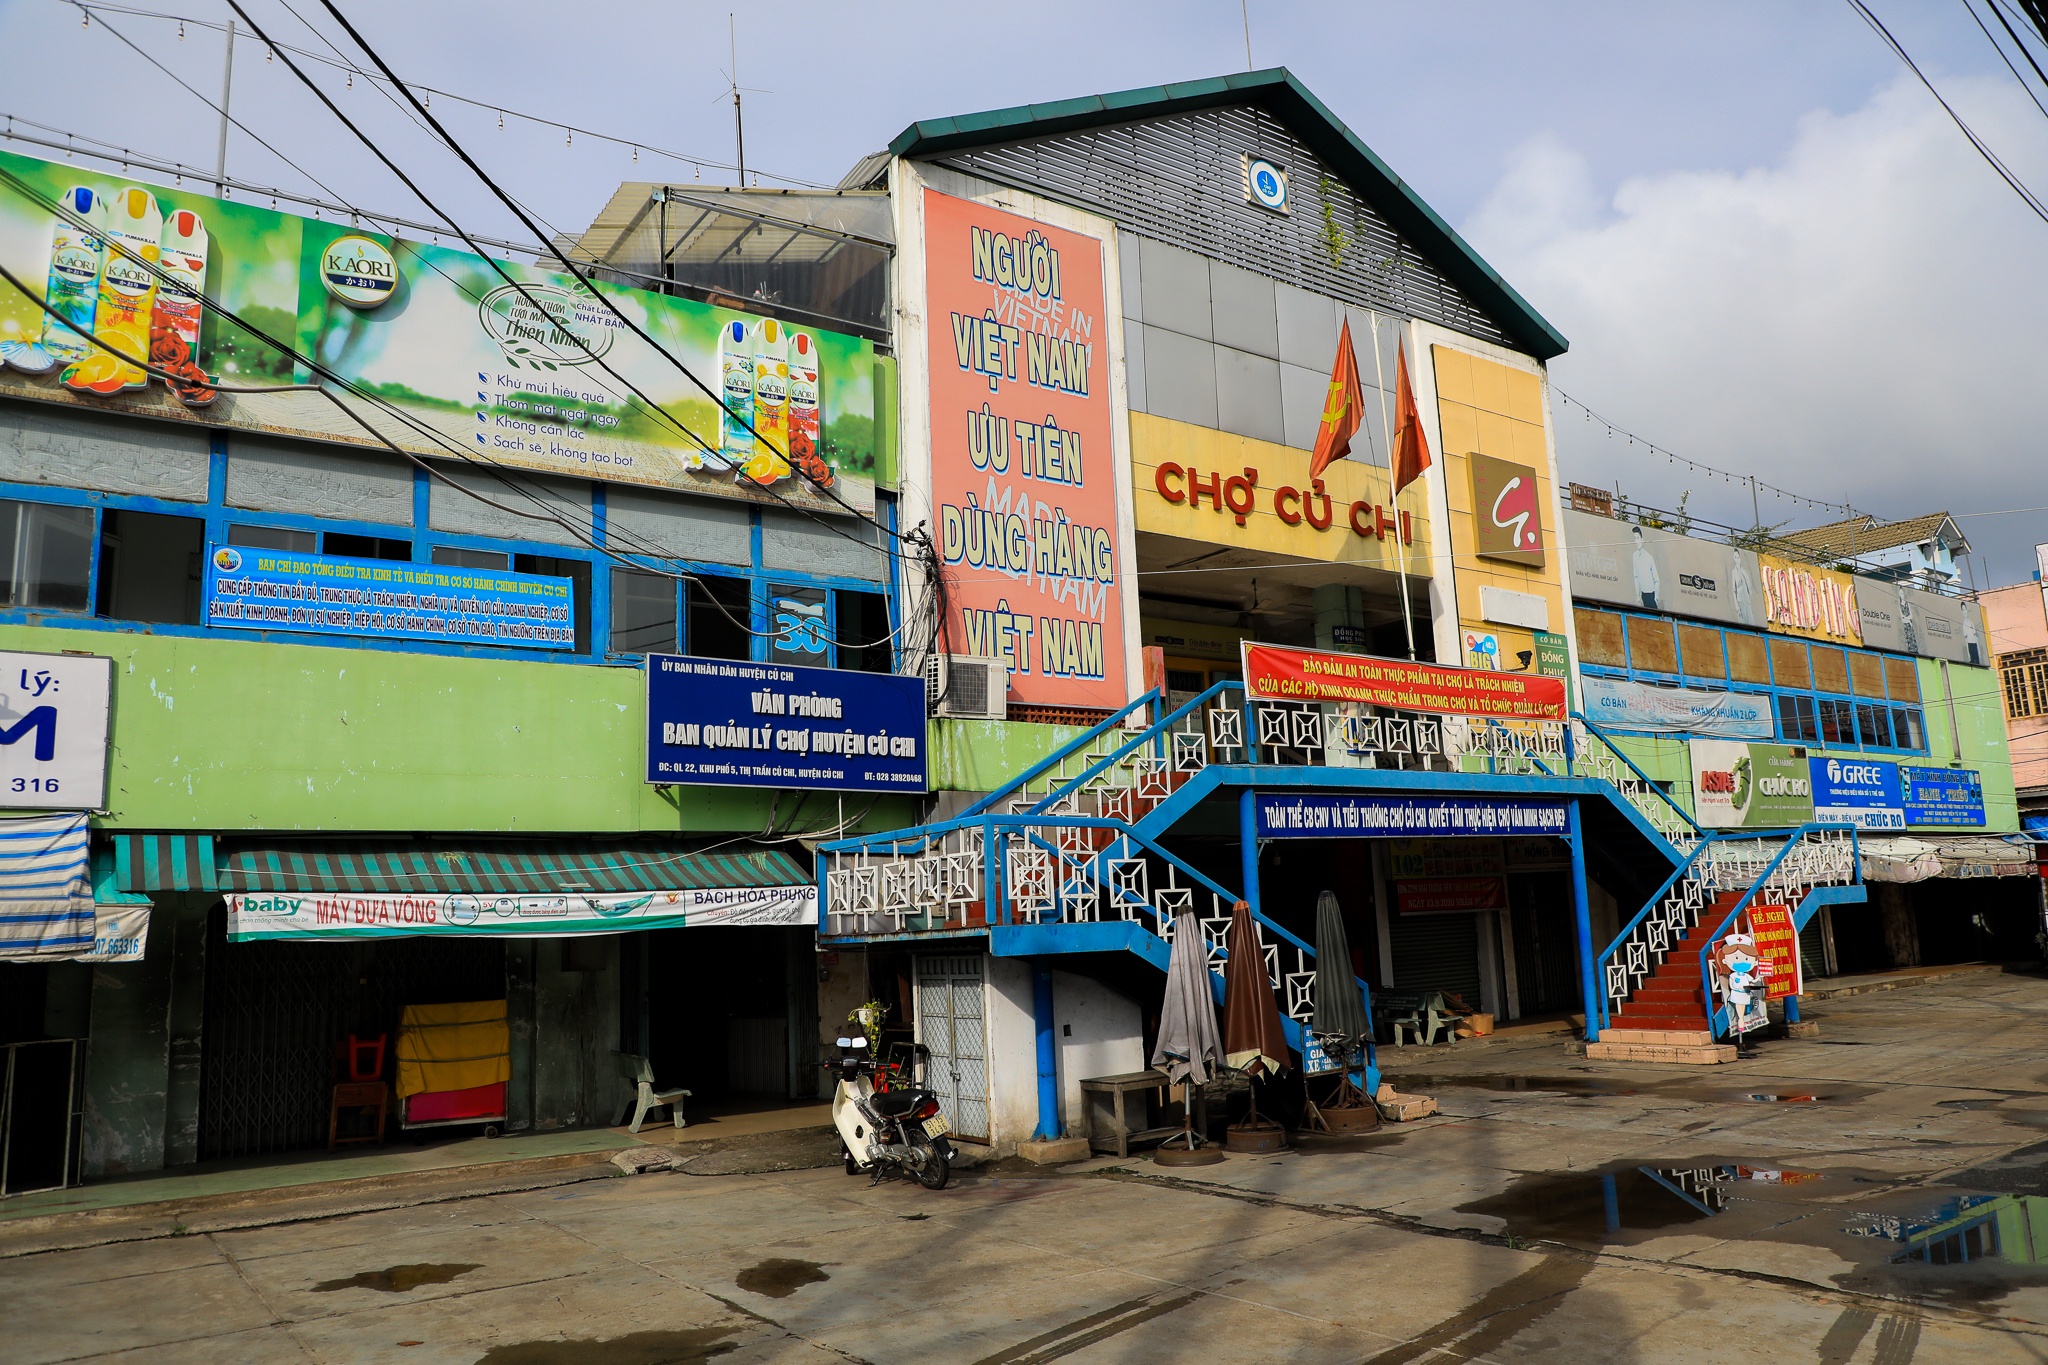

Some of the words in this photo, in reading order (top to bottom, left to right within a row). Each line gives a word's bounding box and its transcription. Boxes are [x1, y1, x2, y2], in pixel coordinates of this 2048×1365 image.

[328, 255, 393, 278] KAORI
[971, 226, 1061, 300] NGƯỜI
[345, 276, 377, 290] かおり
[506, 319, 545, 344] Thiên
[549, 328, 591, 350] Nhiên
[575, 313, 603, 325] NHẬT
[605, 318, 626, 329] BẢN
[951, 309, 1020, 394] VIỆT
[1026, 330, 1089, 398] NAM
[497, 374, 521, 389] Khử
[526, 382, 548, 394] mùi
[553, 383, 578, 399] hiệu
[582, 392, 605, 404] quả
[495, 394, 528, 410] Thơm
[534, 402, 556, 415] mát
[591, 412, 620, 428] ngây
[496, 415, 536, 435] Không
[567, 425, 584, 440] lắc
[494, 435, 524, 451] Sạch
[551, 442, 587, 463] không
[615, 452, 633, 466] bọt
[967, 402, 1010, 475] ƯU
[1015, 414, 1083, 488] TIÊN
[1155, 461, 1258, 526] CHỢ
[1274, 479, 1333, 530] CỦ
[1349, 500, 1413, 545] CHI
[942, 492, 1028, 573] DÙNG
[1034, 507, 1114, 586] HÀNG
[1862, 608, 1879, 619] Double
[1880, 612, 1890, 621] One
[1041, 617, 1105, 681] NAM
[1550, 637, 1562, 645] BÁN
[662, 660, 674, 672] ỦY
[675, 663, 692, 673] BAN
[694, 663, 718, 675] NHÂN
[720, 665, 737, 677] DÂN
[739, 667, 766, 681] HUYỆN
[768, 668, 779, 680] CỦ
[781, 671, 793, 681] CHI
[1303, 655, 1322, 674] BẢO
[1324, 658, 1343, 676] ĐẢM
[1345, 664, 1357, 677] AN
[1359, 662, 1382, 680] TOÀN
[1384, 667, 1405, 684] THỰC
[1407, 665, 1430, 684] PHẨM
[1431, 672, 1444, 688] TẠI
[1446, 674, 1462, 690] CHỢ
[1464, 672, 1474, 688] LÀ
[1476, 674, 1500, 691] TRÁCH
[1502, 678, 1525, 695] NHIỆM
[1470, 651, 1492, 670] BIG
[20, 669, 60, 696] lý:
[1259, 674, 1278, 693] CỦA
[1281, 676, 1302, 694] CÁC
[1304, 678, 1318, 698] HỘ
[1342, 686, 1374, 701] DOANH
[1374, 690, 1396, 705] THỰC
[1398, 688, 1421, 705] PHẨM
[1422, 695, 1449, 708] TRONG
[1450, 698, 1466, 712] CHỢ
[1468, 697, 1478, 711] VÀ
[1480, 696, 1490, 712] TỔ
[1492, 700, 1512, 713] CHỨC
[1514, 700, 1533, 714] QUẢN
[1534, 701, 1543, 715] LÝ
[1544, 706, 1558, 718] CHỢ
[751, 689, 784, 715] VĂN
[789, 692, 842, 719] PHÒNG
[663, 722, 699, 746] BAN
[704, 721, 749, 748] QUẢN
[753, 723, 772, 750] LÝ
[776, 729, 809, 756] CHỢ
[813, 728, 865, 758] HUYỆN
[868, 730, 887, 756] CỦ
[891, 737, 915, 757] CHI
[11, 778, 60, 793] 316
[659, 763, 672, 772] ĐC:
[674, 764, 684, 772] QL
[685, 764, 697, 774] 22,
[700, 765, 715, 773] KHU
[715, 763, 730, 774] PHỐ
[730, 766, 738, 776] 5,
[740, 766, 750, 777] THỊ
[753, 764, 771, 776] TRẤN
[772, 766, 782, 776] CỦ
[783, 768, 797, 779] CHI,
[799, 767, 822, 780] HUYỆN
[822, 768, 832, 778] CỦ
[833, 770, 843, 779] CHI
[864, 772, 875, 780] ĐT:
[876, 772, 889, 781] 028
[891, 773, 921, 782] 38920468
[1759, 772, 1792, 796] CHỨC
[1792, 778, 1810, 797] RO
[1843, 766, 1882, 785] GREE
[1265, 801, 1286, 828] TOÀN
[1287, 798, 1302, 828] THỂ
[1304, 807, 1314, 828] CB
[1314, 807, 1329, 828] CNV
[1331, 802, 1342, 828] VÀ
[1343, 799, 1359, 828] TIỂU
[1390, 806, 1404, 832] CHỢ
[1405, 802, 1414, 827] CỦ
[1415, 808, 1427, 827] CHI
[1429, 800, 1449, 827] QUYẾT
[1450, 803, 1464, 827] TÂM
[1465, 806, 1481, 831] THỰC
[1482, 803, 1497, 831] HIỆN
[1498, 807, 1510, 831] CHỢ
[1510, 803, 1523, 827] VĂN
[1523, 809, 1537, 827] MINH
[1538, 809, 1554, 830] SẠCH
[1555, 809, 1565, 830] ĐẸP
[1392, 854, 1423, 875] 102
[244, 897, 302, 916] baby
[316, 894, 351, 924] MÁY
[354, 900, 389, 924] ĐƯA
[393, 895, 437, 924] VÕNG
[694, 889, 733, 904] BÁCH
[737, 888, 766, 903] HÓA
[770, 887, 816, 904] PHỤNG
